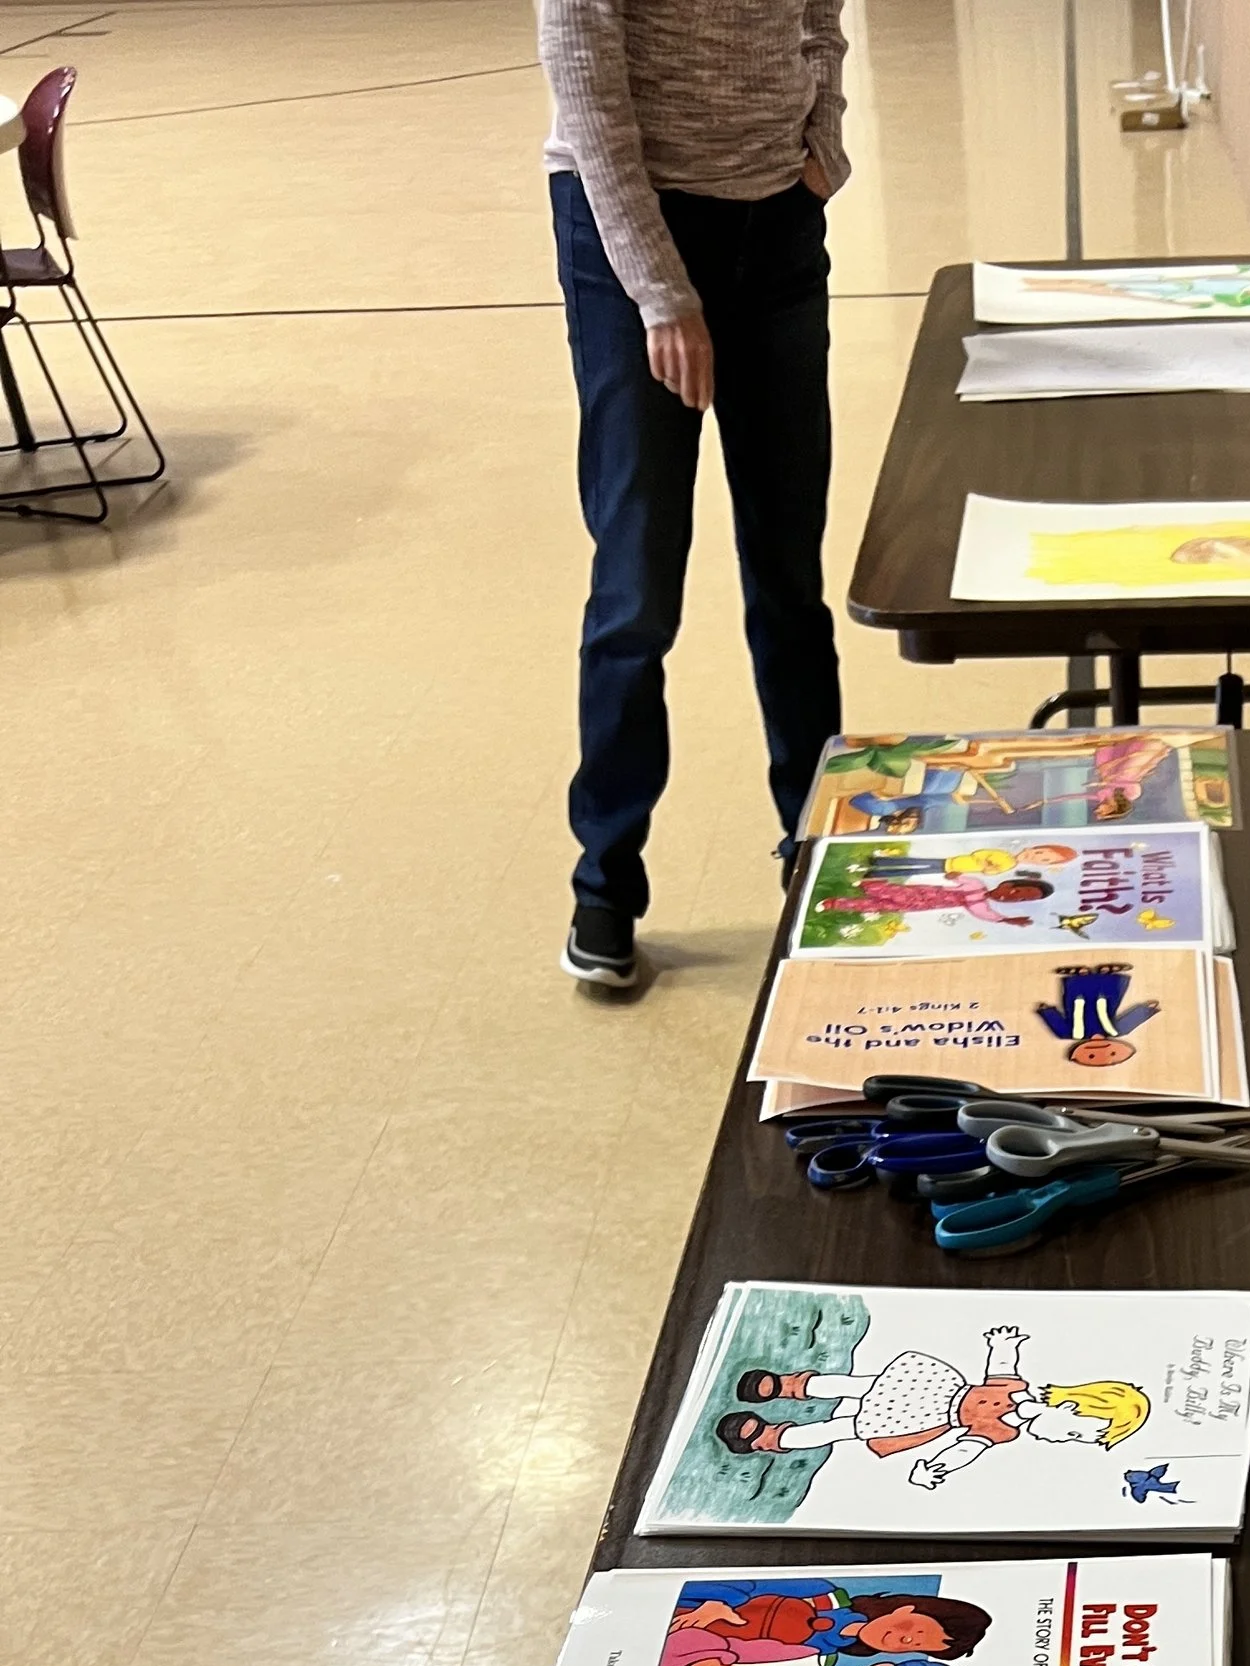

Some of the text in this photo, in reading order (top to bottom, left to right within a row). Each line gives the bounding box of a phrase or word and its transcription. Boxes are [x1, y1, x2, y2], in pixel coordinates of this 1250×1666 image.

[1079, 848, 1133, 916] Faith?
[1140, 850, 1173, 904] What Is
[825, 1020, 1004, 1035] Widow's Oil
[806, 1035, 1020, 1050] Elisha and the
[1037, 1597, 1054, 1615] THE
[1035, 1618, 1052, 1650] STORY
